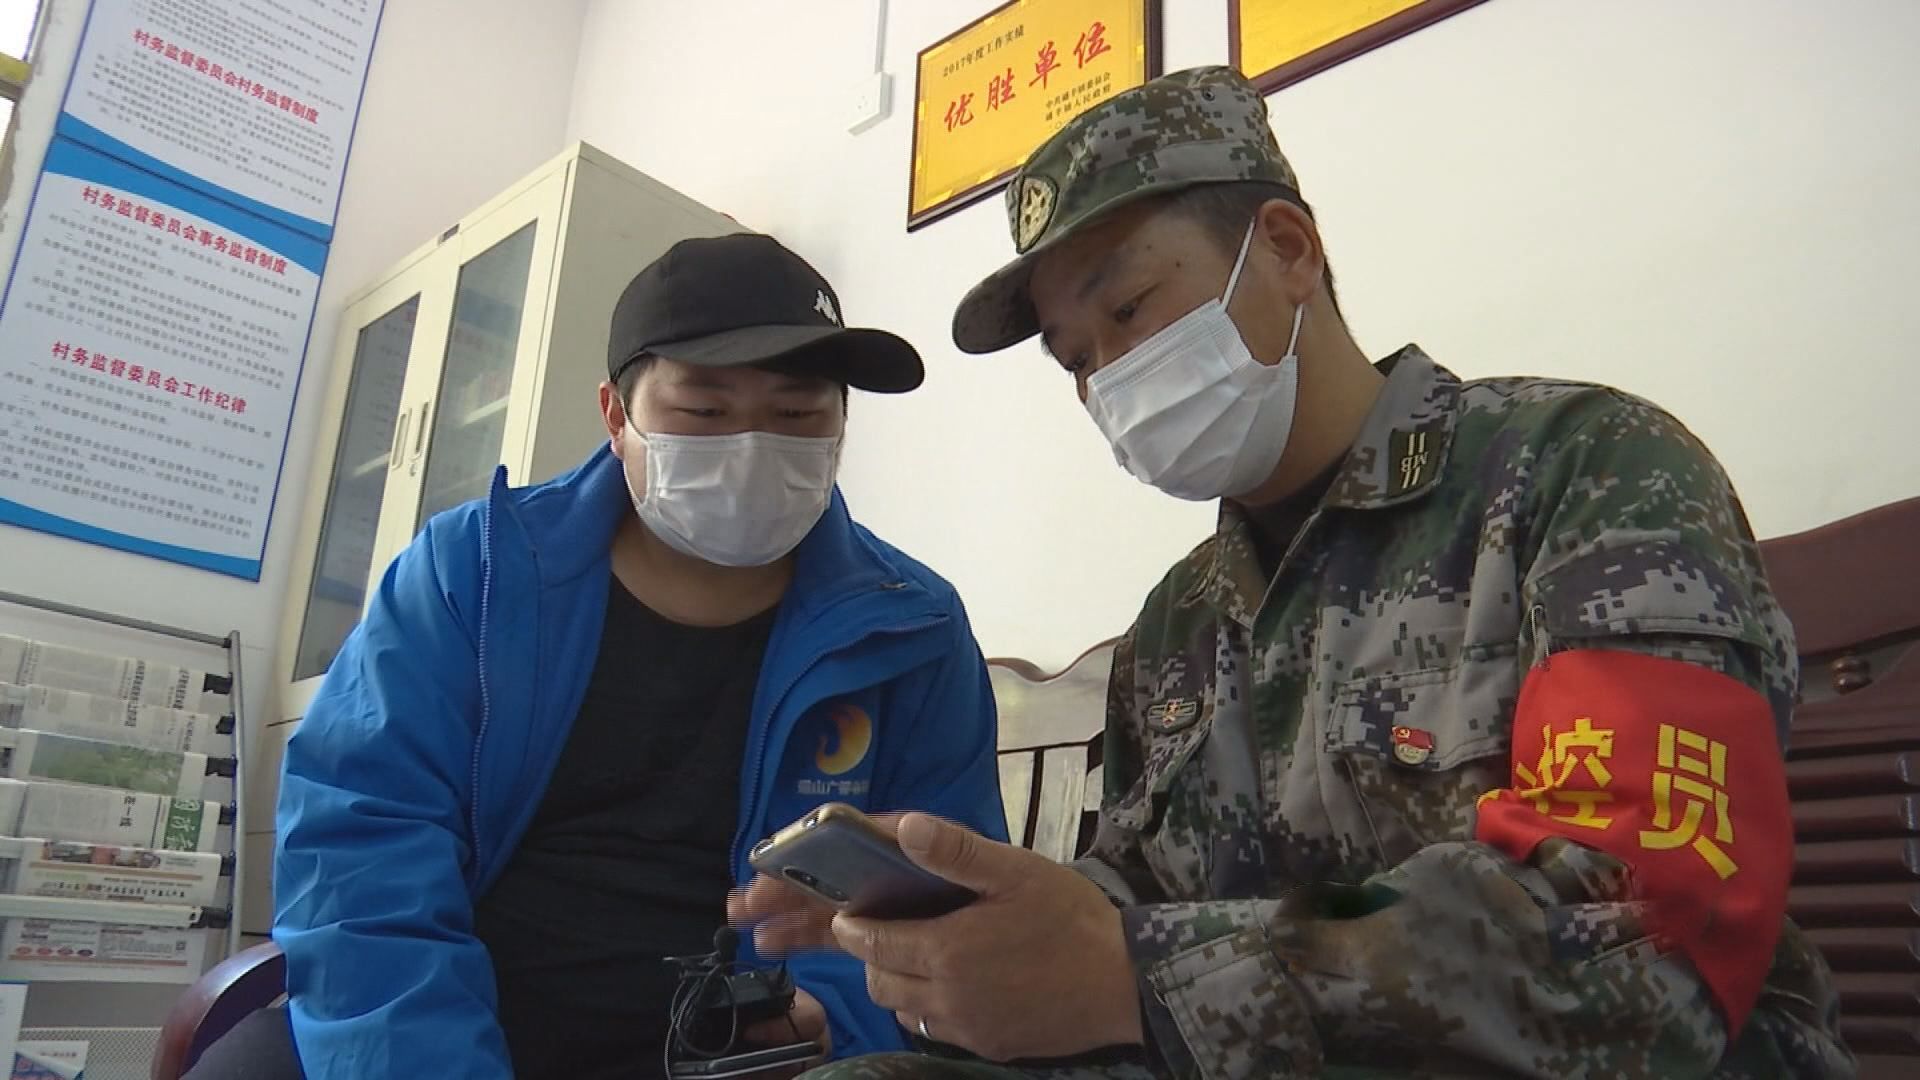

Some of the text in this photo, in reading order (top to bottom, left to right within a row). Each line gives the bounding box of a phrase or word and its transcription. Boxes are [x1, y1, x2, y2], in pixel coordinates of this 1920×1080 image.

[133, 28, 320, 125] 村务监督委员会村务监督制度
[943, 21, 1112, 133] 优胜单位
[81, 184, 288, 276] 村务监督委员会事务监督制度
[51, 341, 248, 415] 村务监督委员会工作纪律
[1477, 718, 1738, 880] 控员
